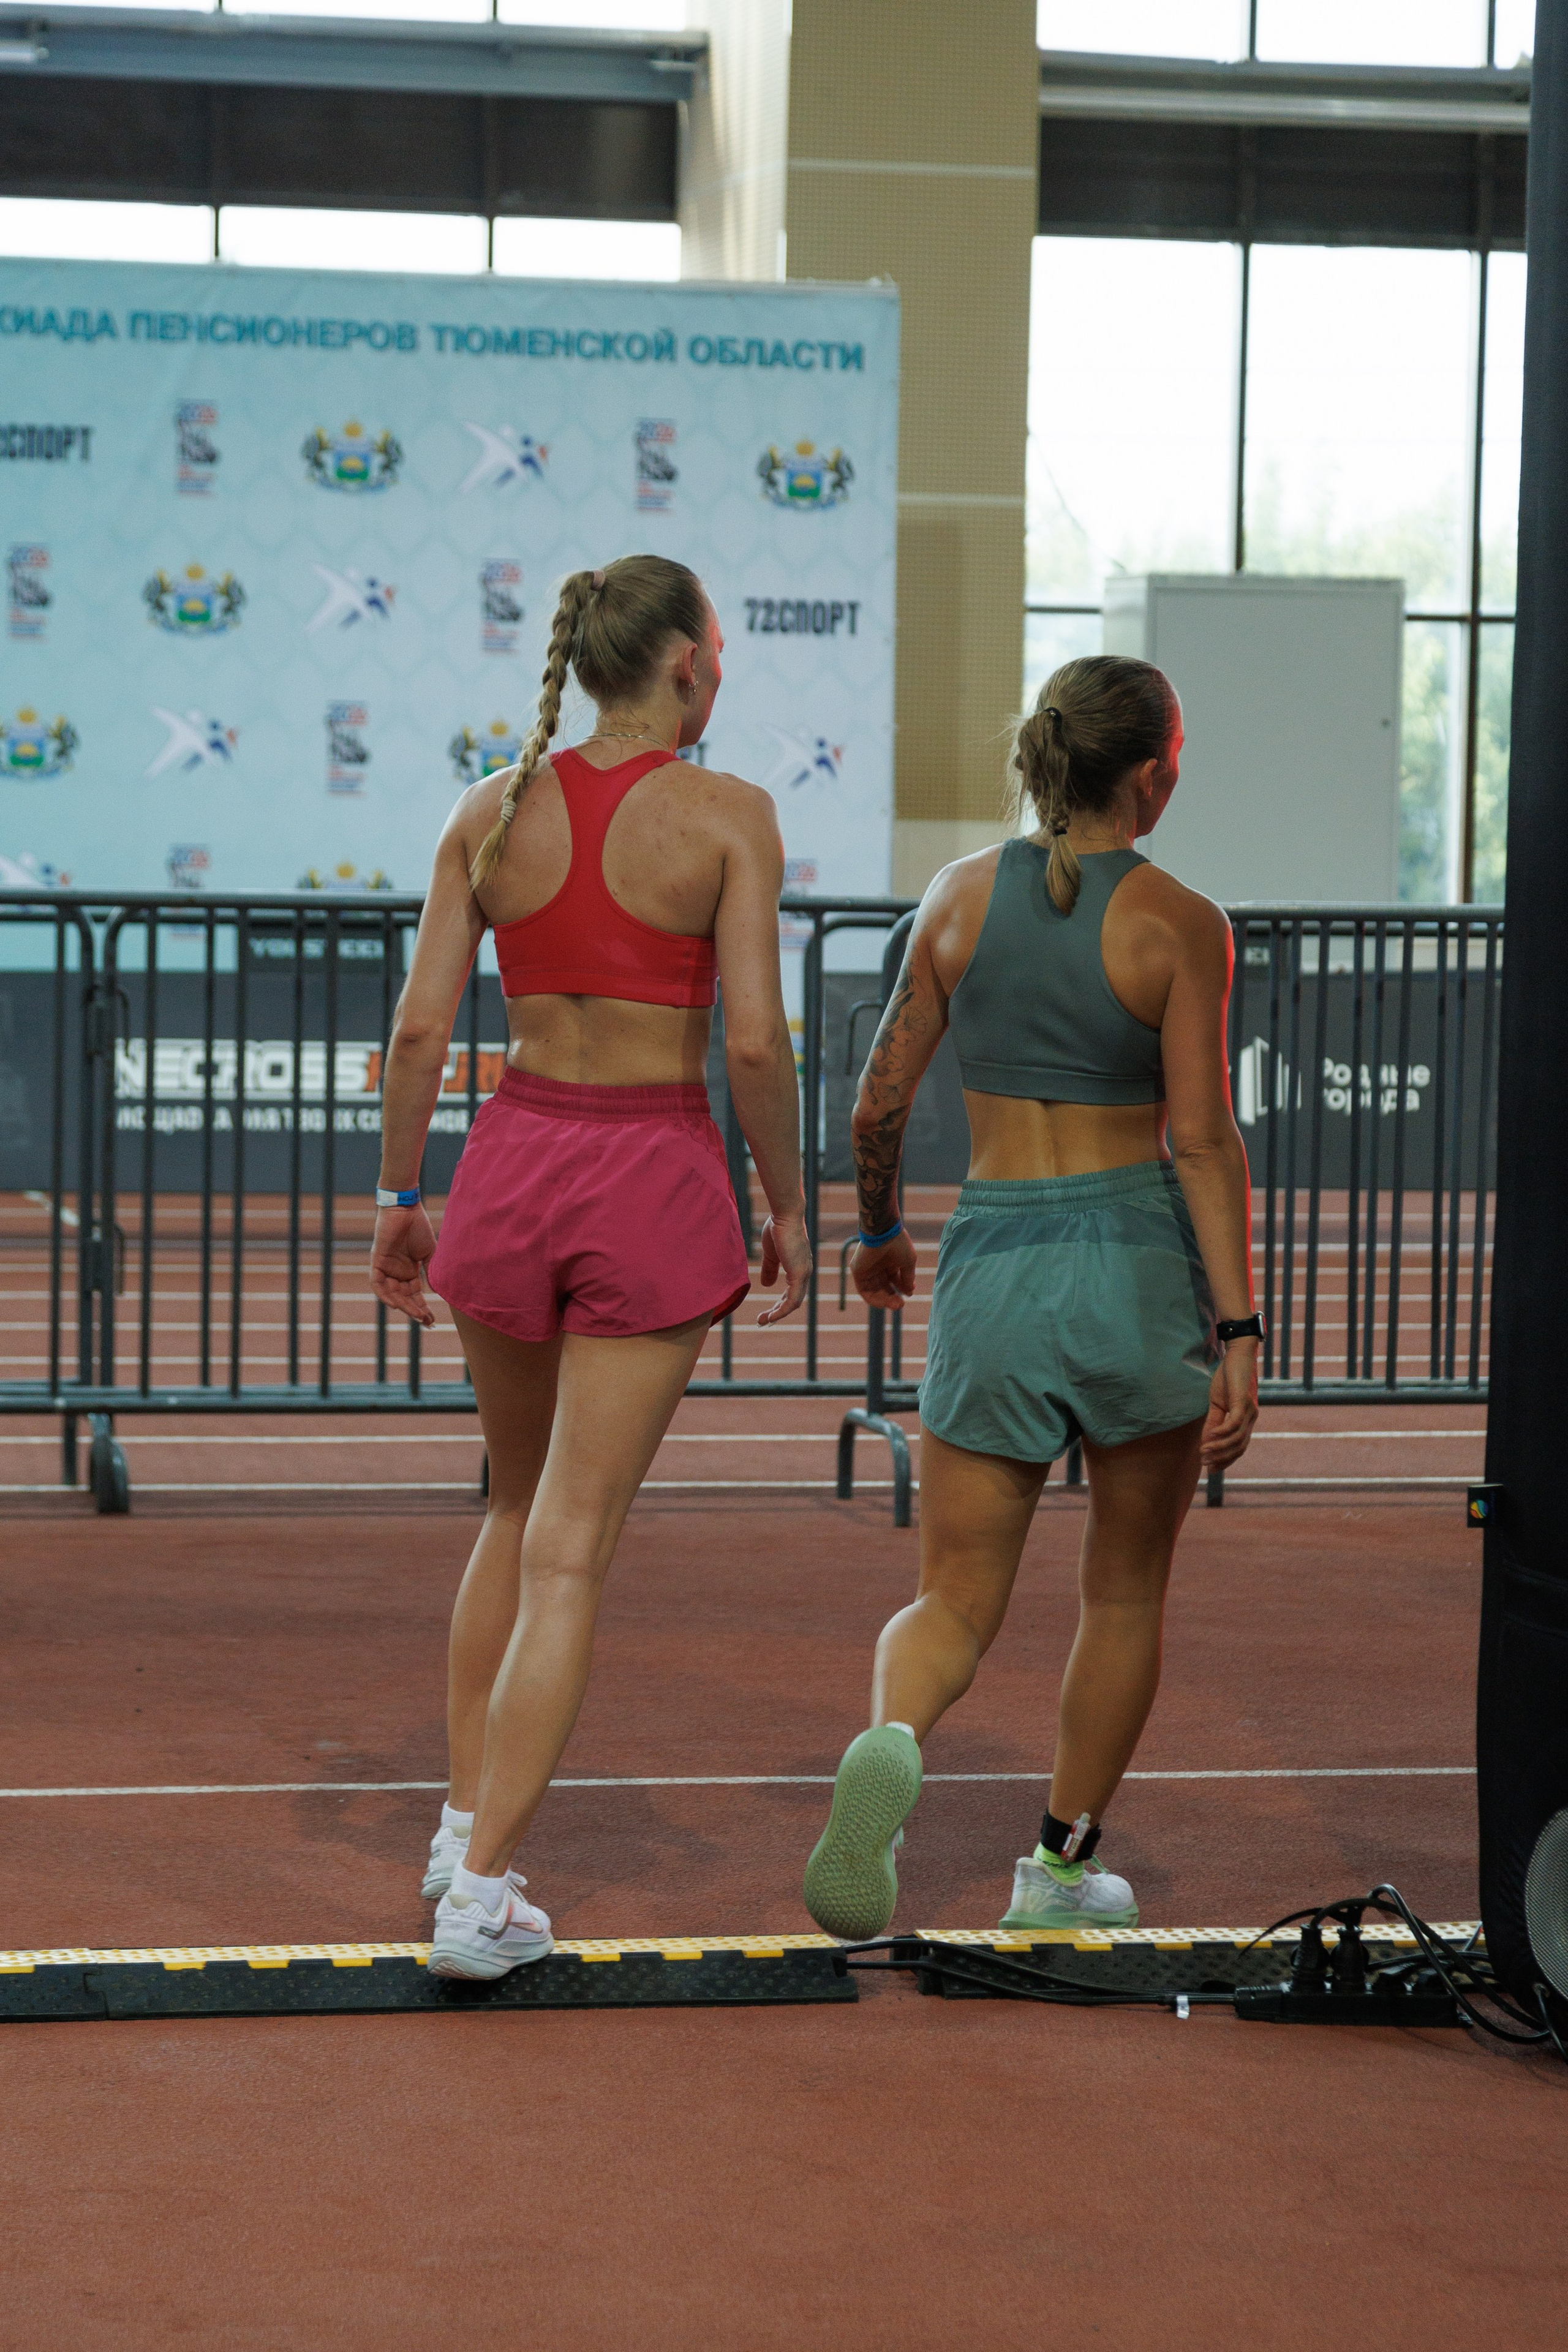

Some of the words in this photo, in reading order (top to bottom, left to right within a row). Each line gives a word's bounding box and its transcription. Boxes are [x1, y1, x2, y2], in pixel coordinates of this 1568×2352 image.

[129, 311, 418, 352] ПЕНСИОНЕРОВ
[428, 323, 675, 361] ТЮМЕНСКОЙ
[687, 334, 865, 370] ОБЛАСТИ
[745, 598, 861, 636] 72СПОРТ
